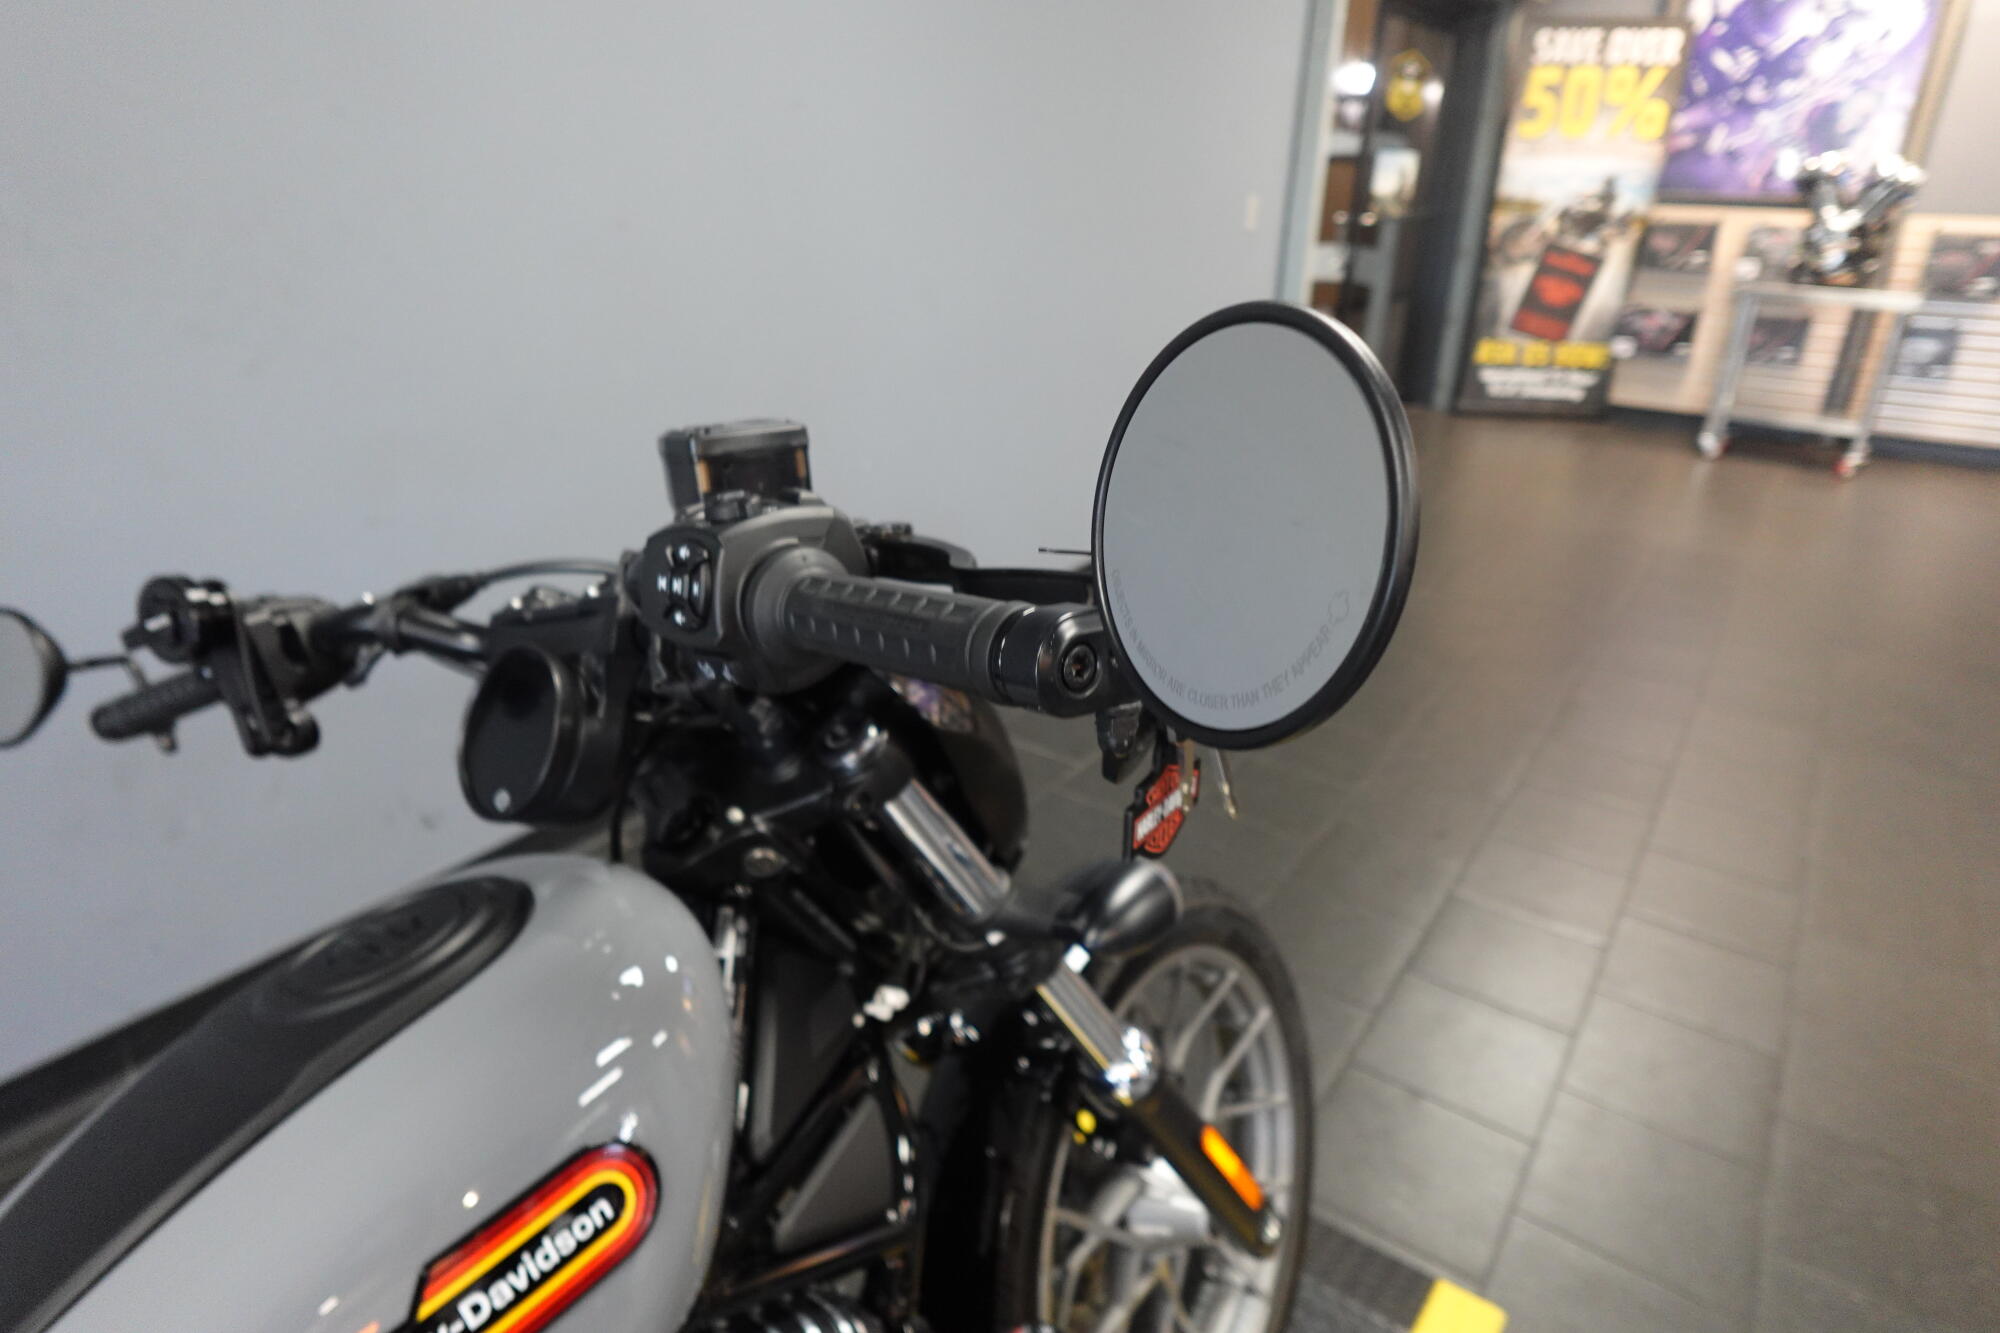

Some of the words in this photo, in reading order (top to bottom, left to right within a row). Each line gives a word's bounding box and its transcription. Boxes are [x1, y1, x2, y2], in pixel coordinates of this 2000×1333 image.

[1518, 65, 1671, 140] 50%
[1187, 688, 1228, 710] CLOSER
[1231, 689, 1260, 709] THAN
[1262, 669, 1290, 699] THEY
[1291, 625, 1330, 678] APPEAR
